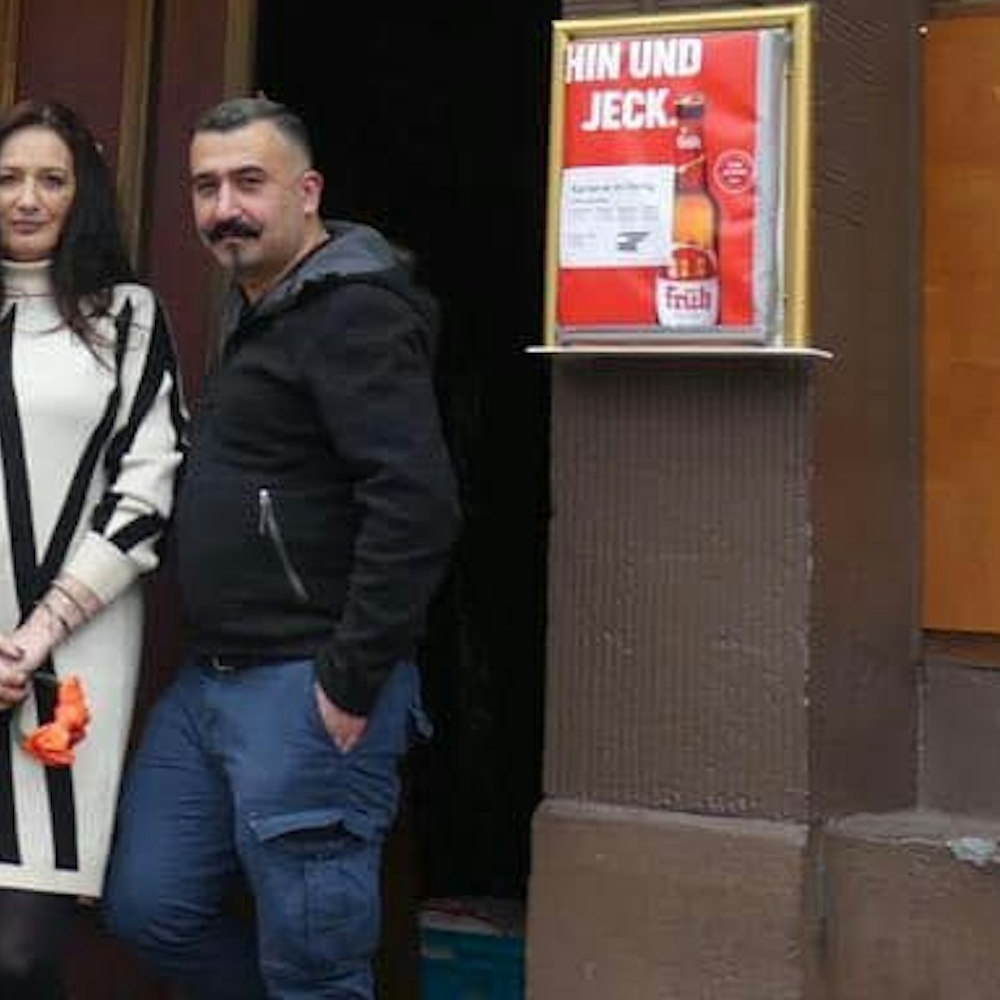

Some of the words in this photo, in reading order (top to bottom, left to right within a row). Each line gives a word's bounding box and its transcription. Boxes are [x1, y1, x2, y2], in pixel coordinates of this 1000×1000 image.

[566, 40, 621, 83] HIN
[628, 36, 703, 79] UND
[580, 86, 678, 132] JECK.
